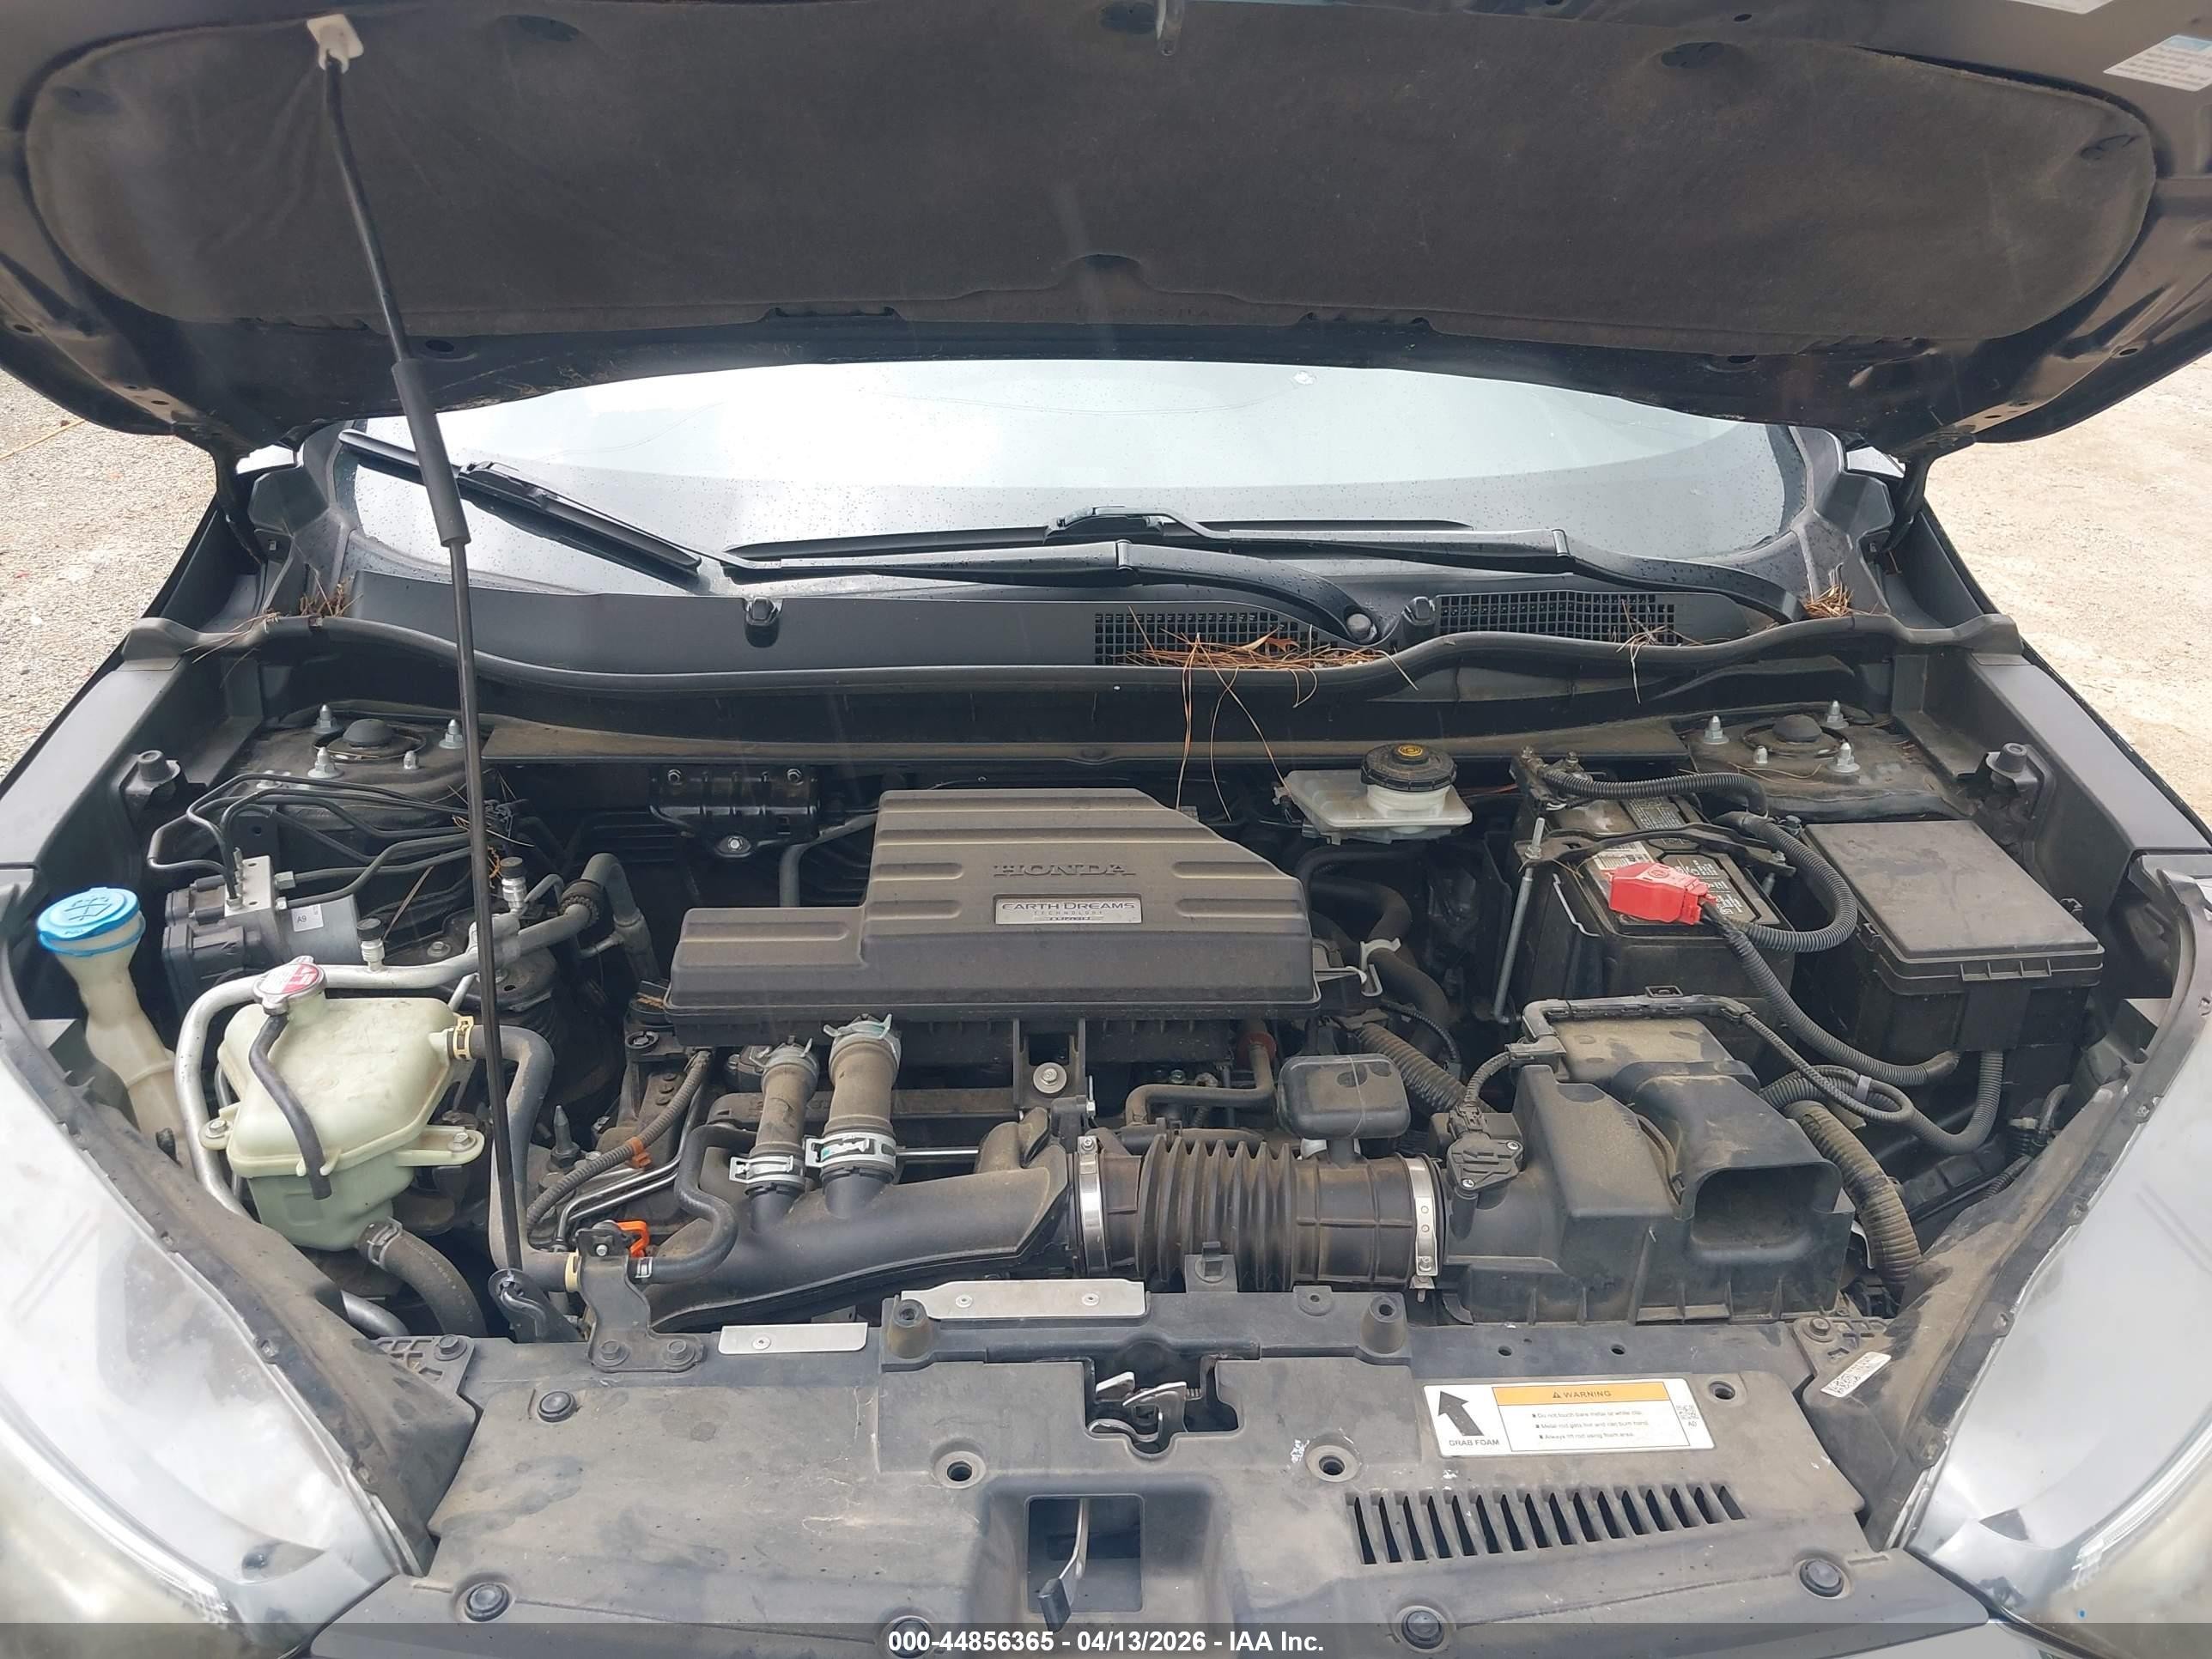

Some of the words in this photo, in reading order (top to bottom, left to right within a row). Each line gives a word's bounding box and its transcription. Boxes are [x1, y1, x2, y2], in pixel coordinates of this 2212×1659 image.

[994, 864, 1136, 877] HONDA
[1564, 1389, 1612, 1400] WARNING
[1449, 1439, 1474, 1448] GRAB
